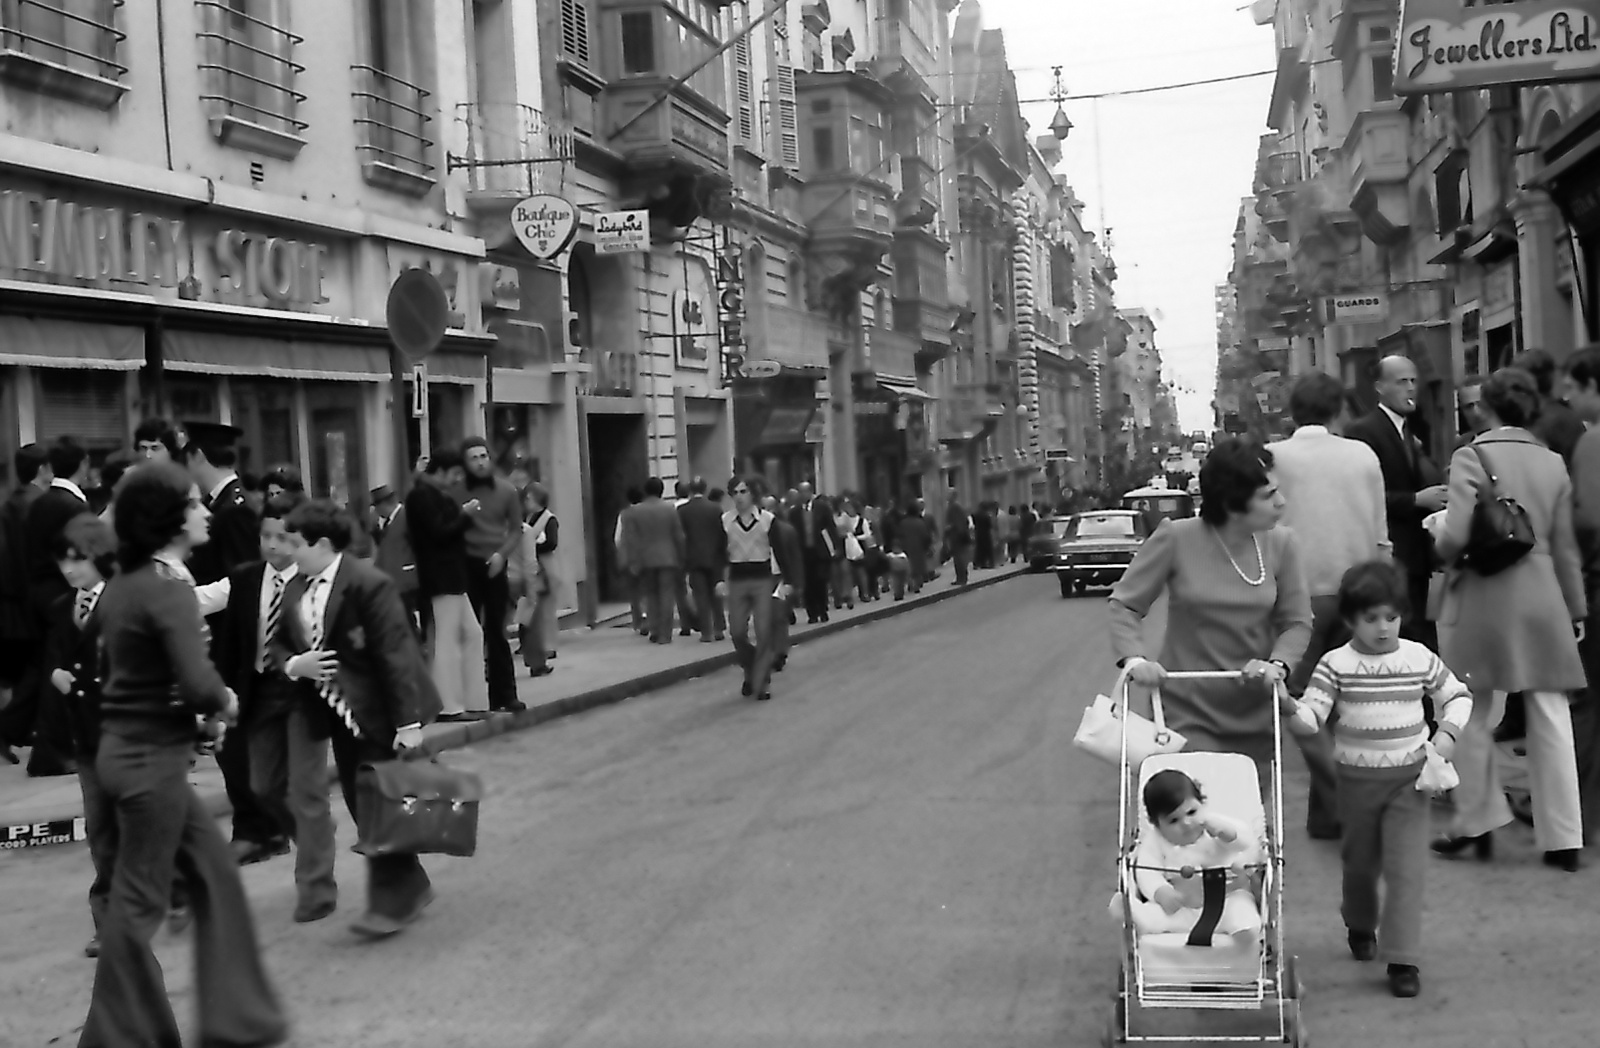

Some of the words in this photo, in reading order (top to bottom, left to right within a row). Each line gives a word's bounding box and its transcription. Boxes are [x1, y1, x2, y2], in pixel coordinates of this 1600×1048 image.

[1409, 19, 1542, 79] Jewellers
[1547, 12, 1597, 54] Ltd.
[517, 203, 570, 226] Boutique
[597, 214, 643, 237] Ladybird
[525, 223, 556, 239] Chic
[216, 229, 330, 305] STORE
[1336, 297, 1380, 308] GUARDS
[30, 834, 70, 846] PLAYERS
